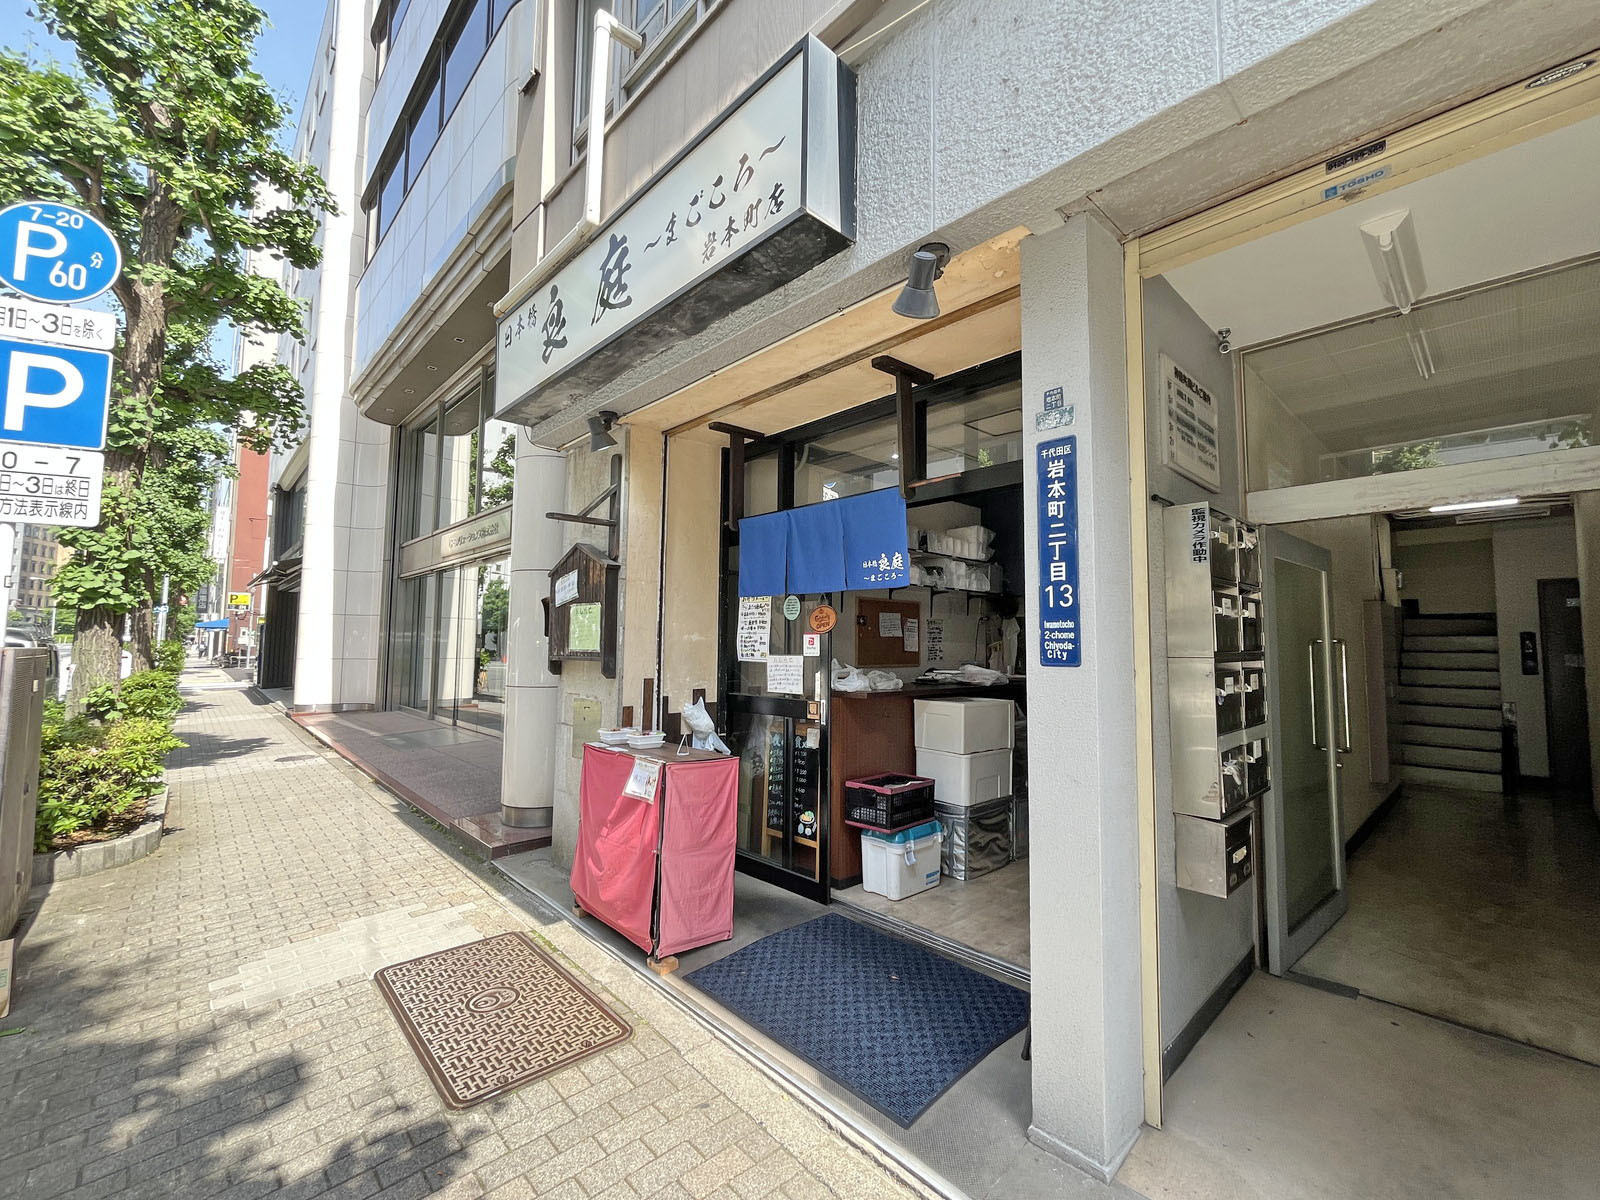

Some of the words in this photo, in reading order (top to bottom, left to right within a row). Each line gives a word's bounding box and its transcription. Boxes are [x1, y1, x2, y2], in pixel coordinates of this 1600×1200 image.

[28, 206, 84, 230] 7-20
[702, 182, 785, 264] 岩本町店
[13, 220, 68, 281] P
[503, 303, 537, 349] 日本橋
[4, 350, 84, 431] P
[1040, 444, 1072, 458] 千代田区
[0, 498, 88, 520] 方法表示線内
[1046, 458, 1067, 582] 岩本町二丁目
[1191, 507, 1207, 563] 監視カメラ作動中
[878, 551, 904, 571] 良庭
[230, 594, 239, 604] P
[1044, 585, 1073, 608] 13
[1043, 620, 1075, 629] Iwamotocho
[1044, 631, 1075, 639] 2-chome
[1047, 650, 1068, 661] City
